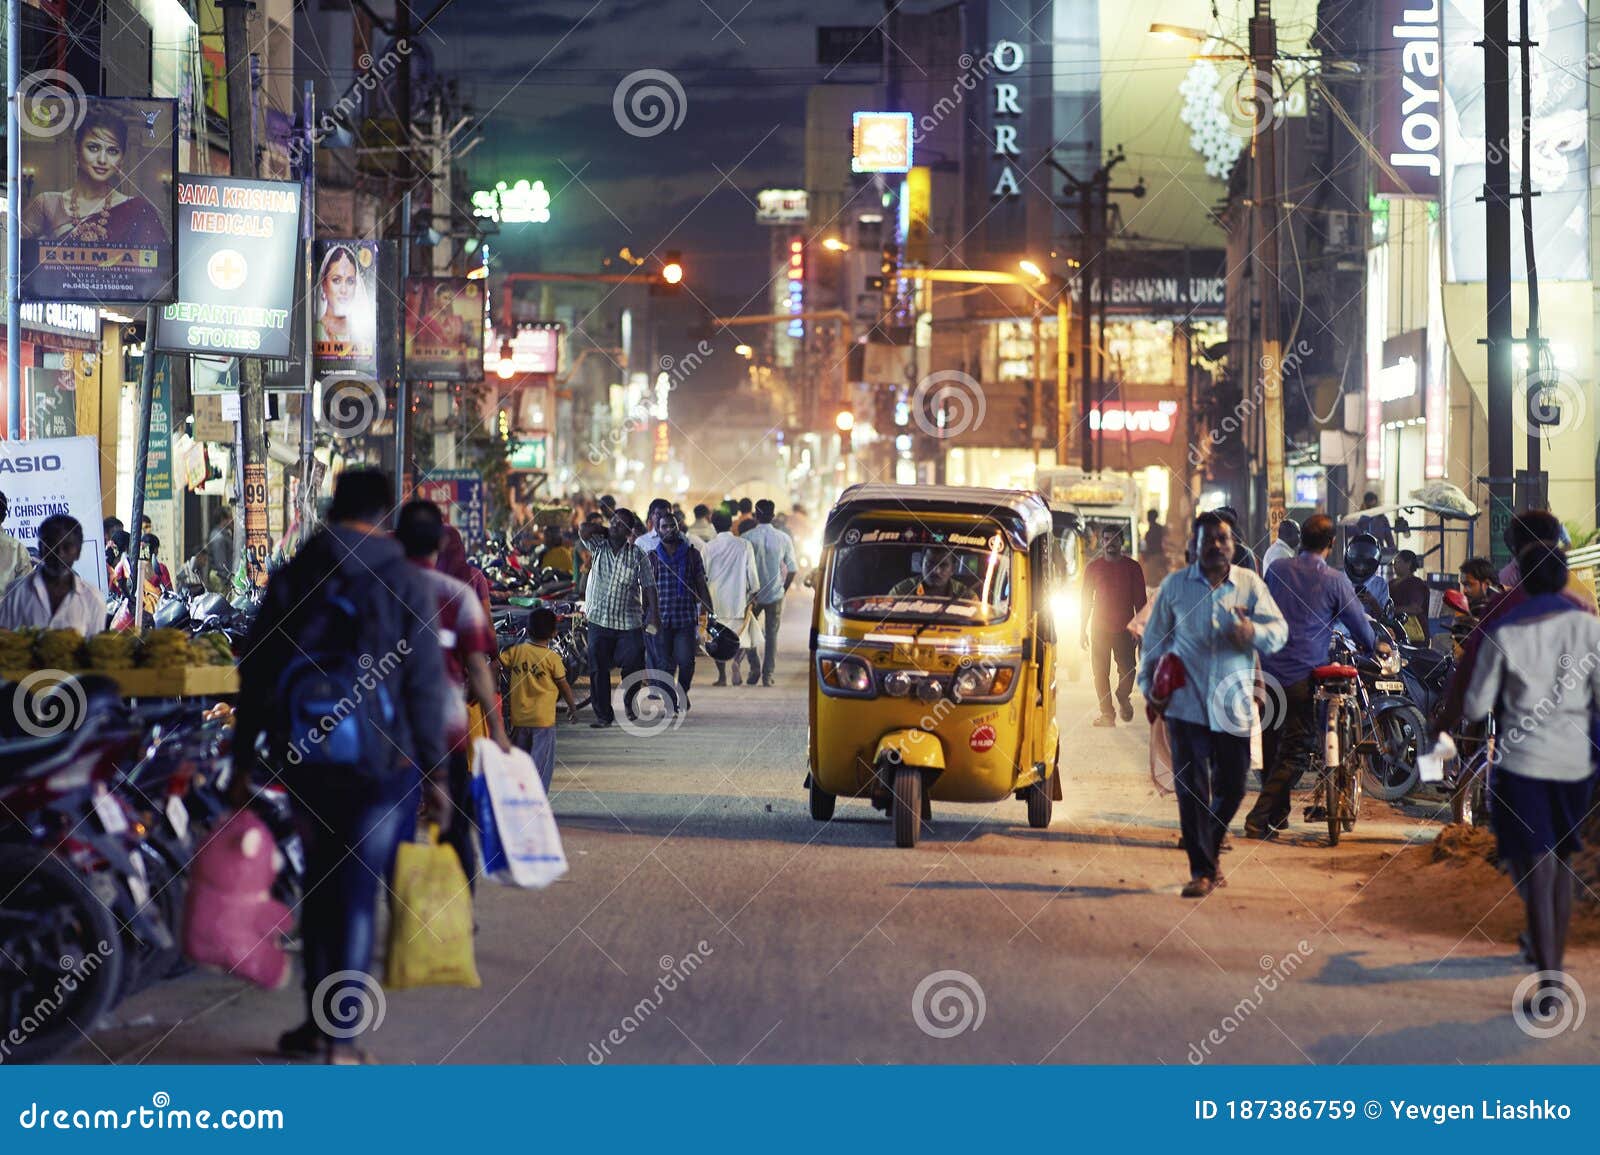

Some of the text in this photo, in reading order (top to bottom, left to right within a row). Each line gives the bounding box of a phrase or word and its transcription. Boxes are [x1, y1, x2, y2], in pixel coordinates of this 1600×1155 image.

[993, 41, 1024, 195] ORRA
[178, 183, 296, 213] RAMA KRISHNA
[191, 211, 274, 238] MEDICALS
[45, 250, 134, 263] BHIMA
[164, 302, 288, 328] DEPARTMENT
[187, 326, 261, 350] STORES
[317, 344, 359, 352] HIMA
[0, 455, 61, 474] ASIO
[246, 484, 265, 504] 99
[15, 502, 70, 517] CHRISTMAS
